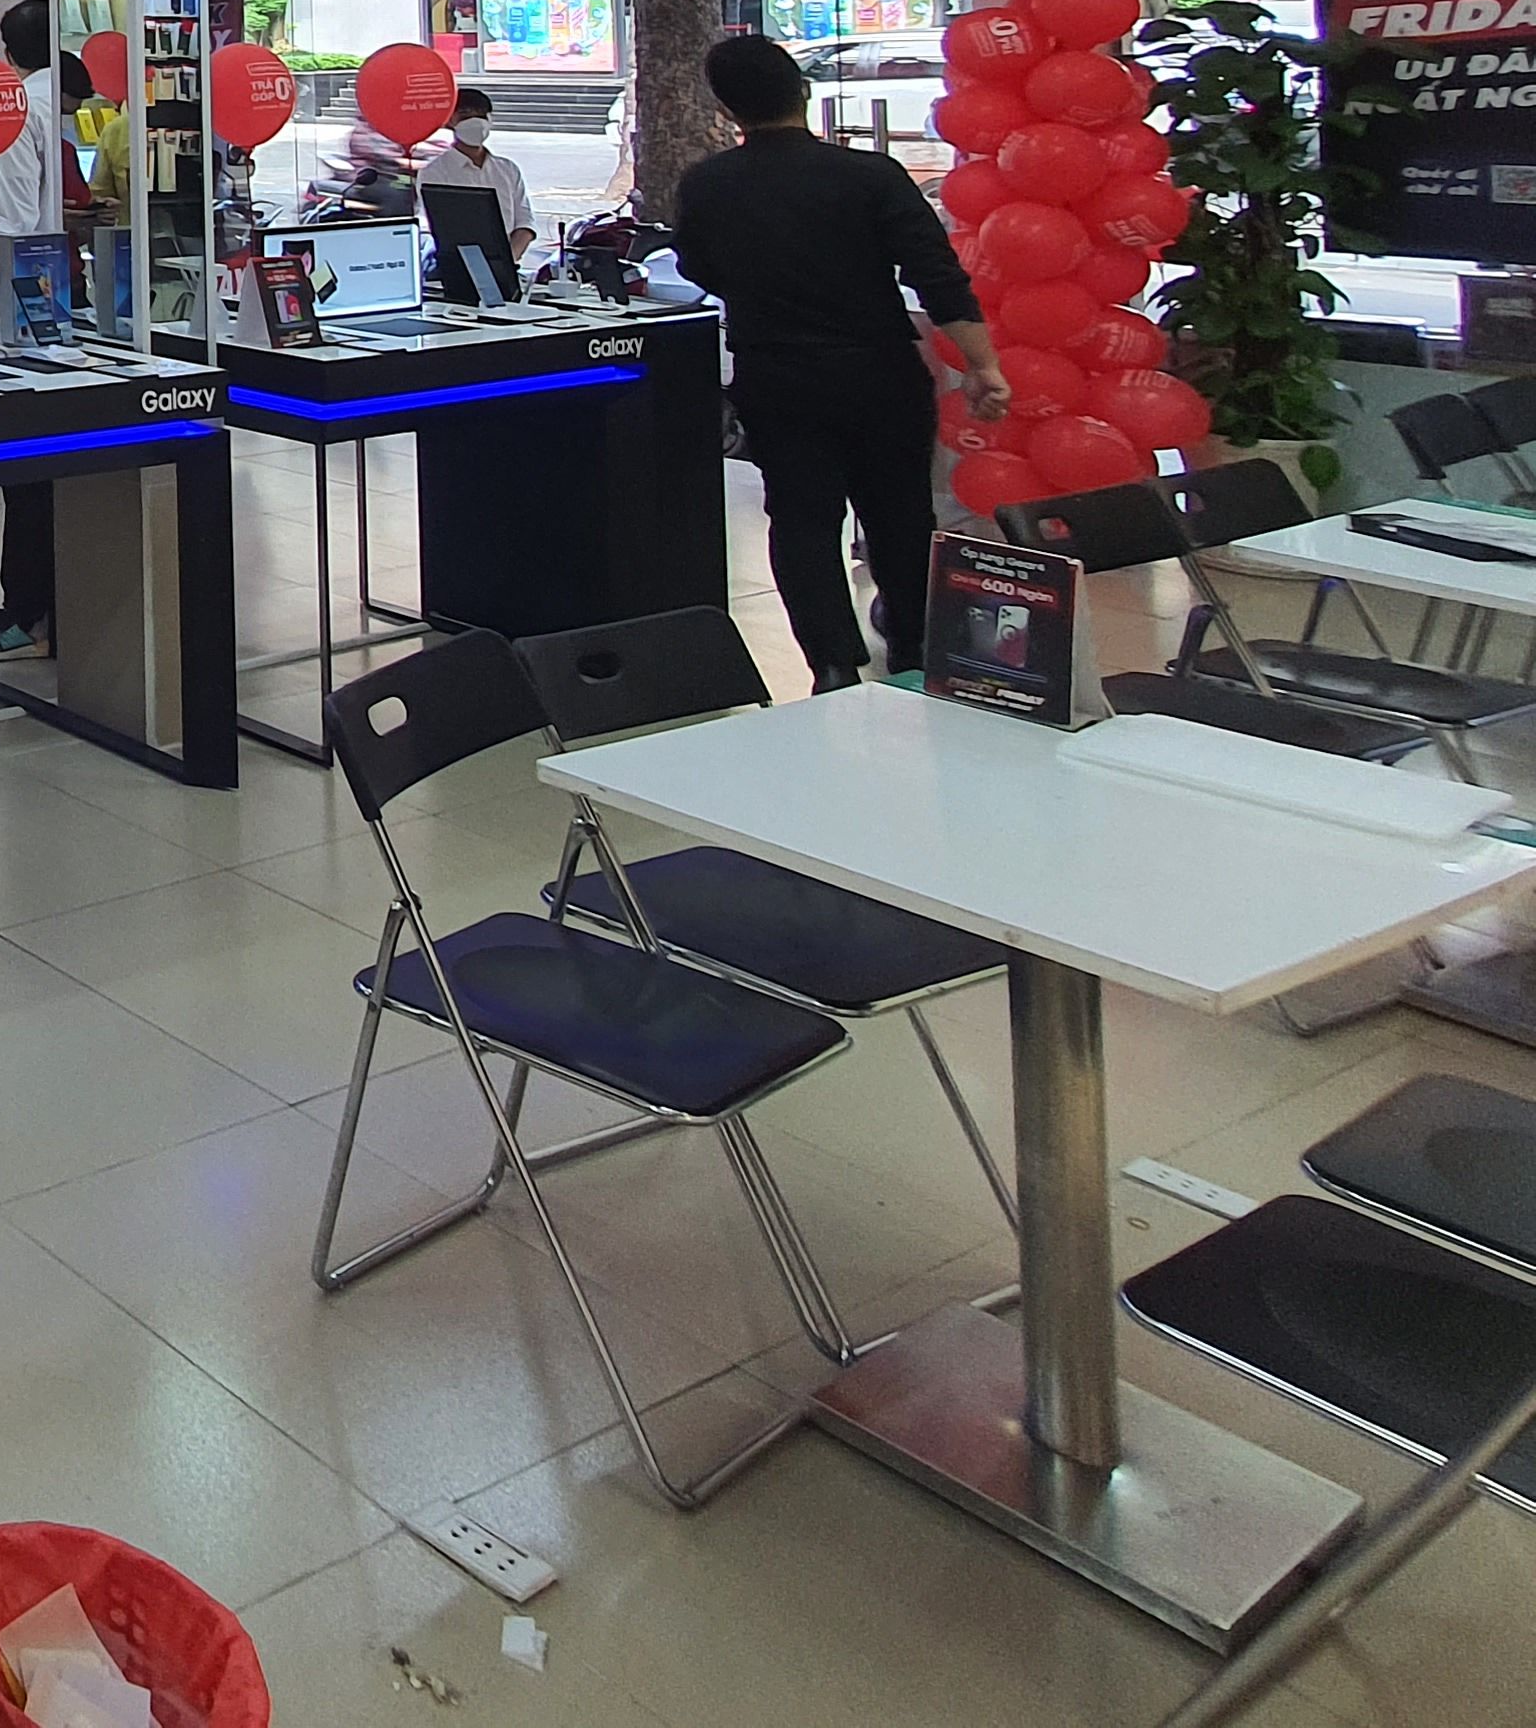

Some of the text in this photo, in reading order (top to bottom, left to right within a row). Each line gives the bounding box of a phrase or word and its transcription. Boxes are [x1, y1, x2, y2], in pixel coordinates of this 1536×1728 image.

[587, 335, 645, 361] Galaxy
[140, 386, 217, 415] Galaxy
[981, 578, 1015, 596] 600
